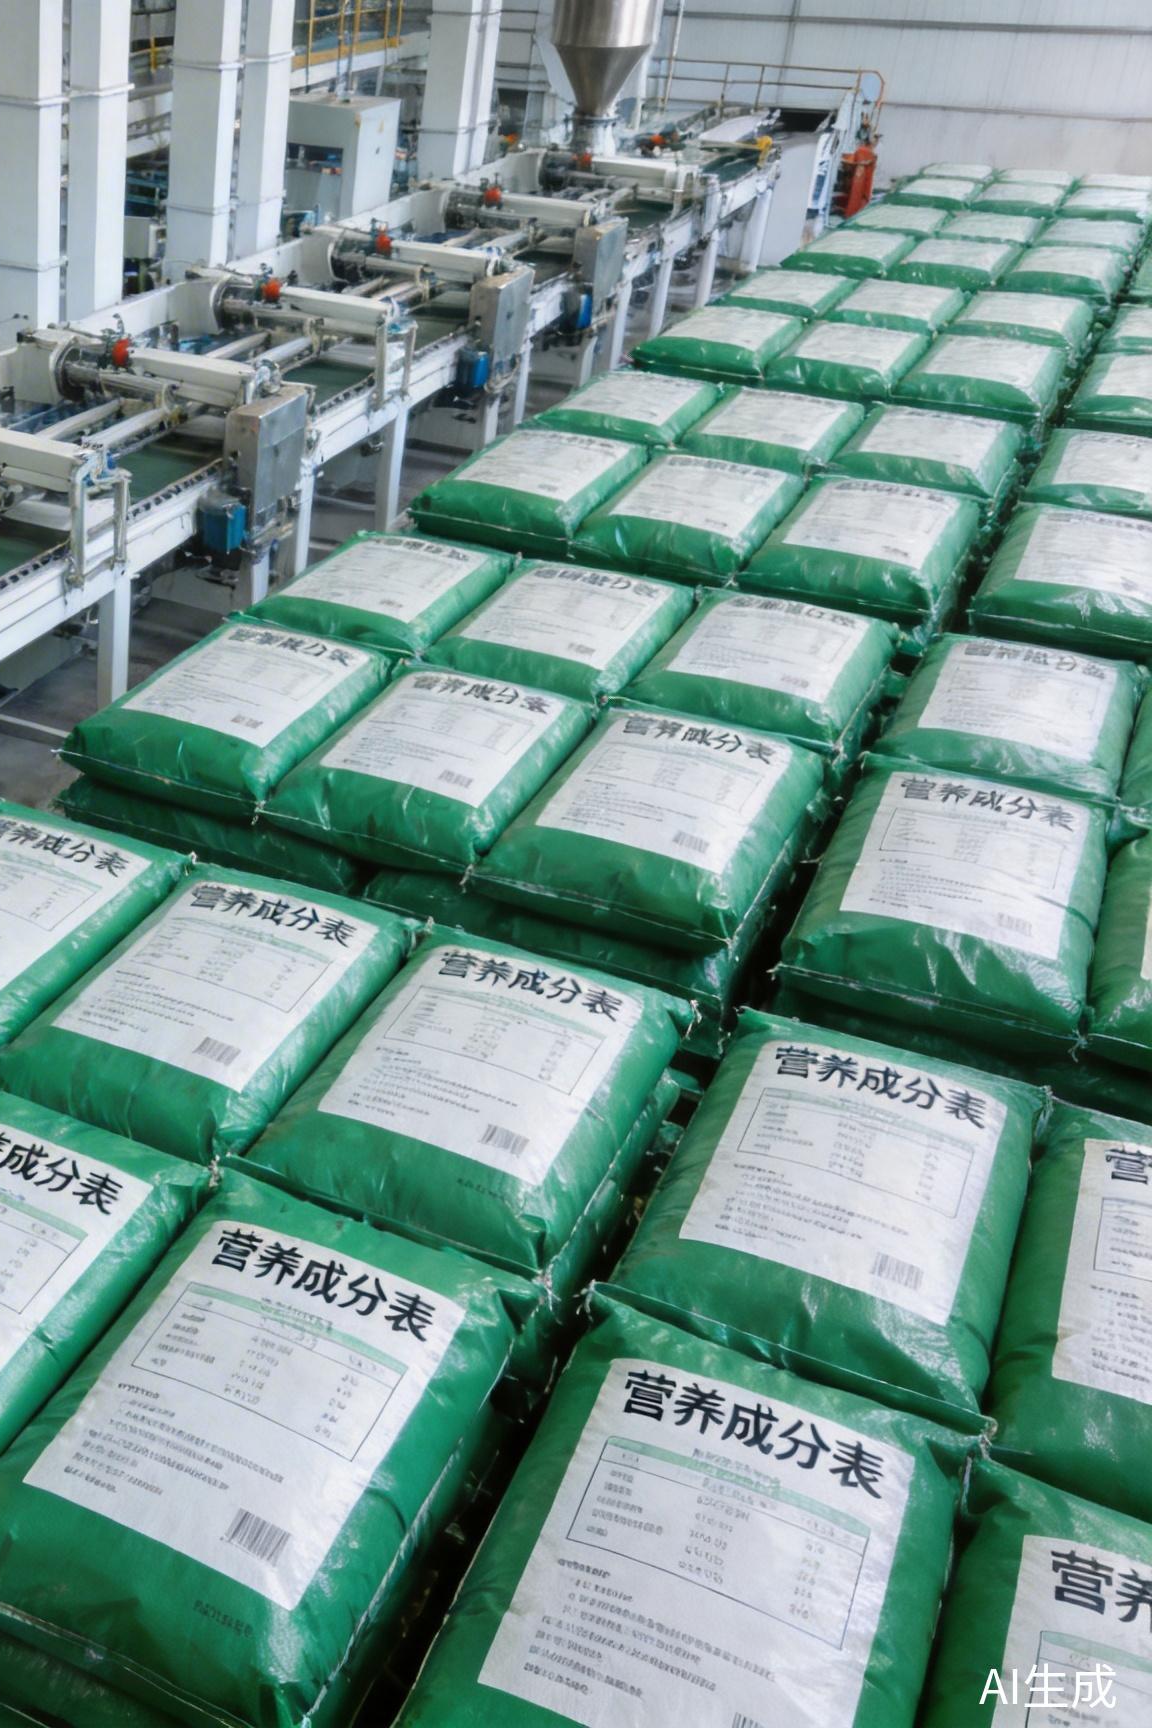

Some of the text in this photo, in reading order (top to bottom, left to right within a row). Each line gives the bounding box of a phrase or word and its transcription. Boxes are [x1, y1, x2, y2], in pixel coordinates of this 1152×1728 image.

[190, 885, 357, 948] 营养成分表
[438, 952, 623, 1022] 营养成分表
[776, 1046, 987, 1129] 营养成分表
[1106, 1149, 1152, 1184] 营
[212, 1228, 436, 1342] 营养成分表
[622, 1369, 884, 1500] 营养成分表
